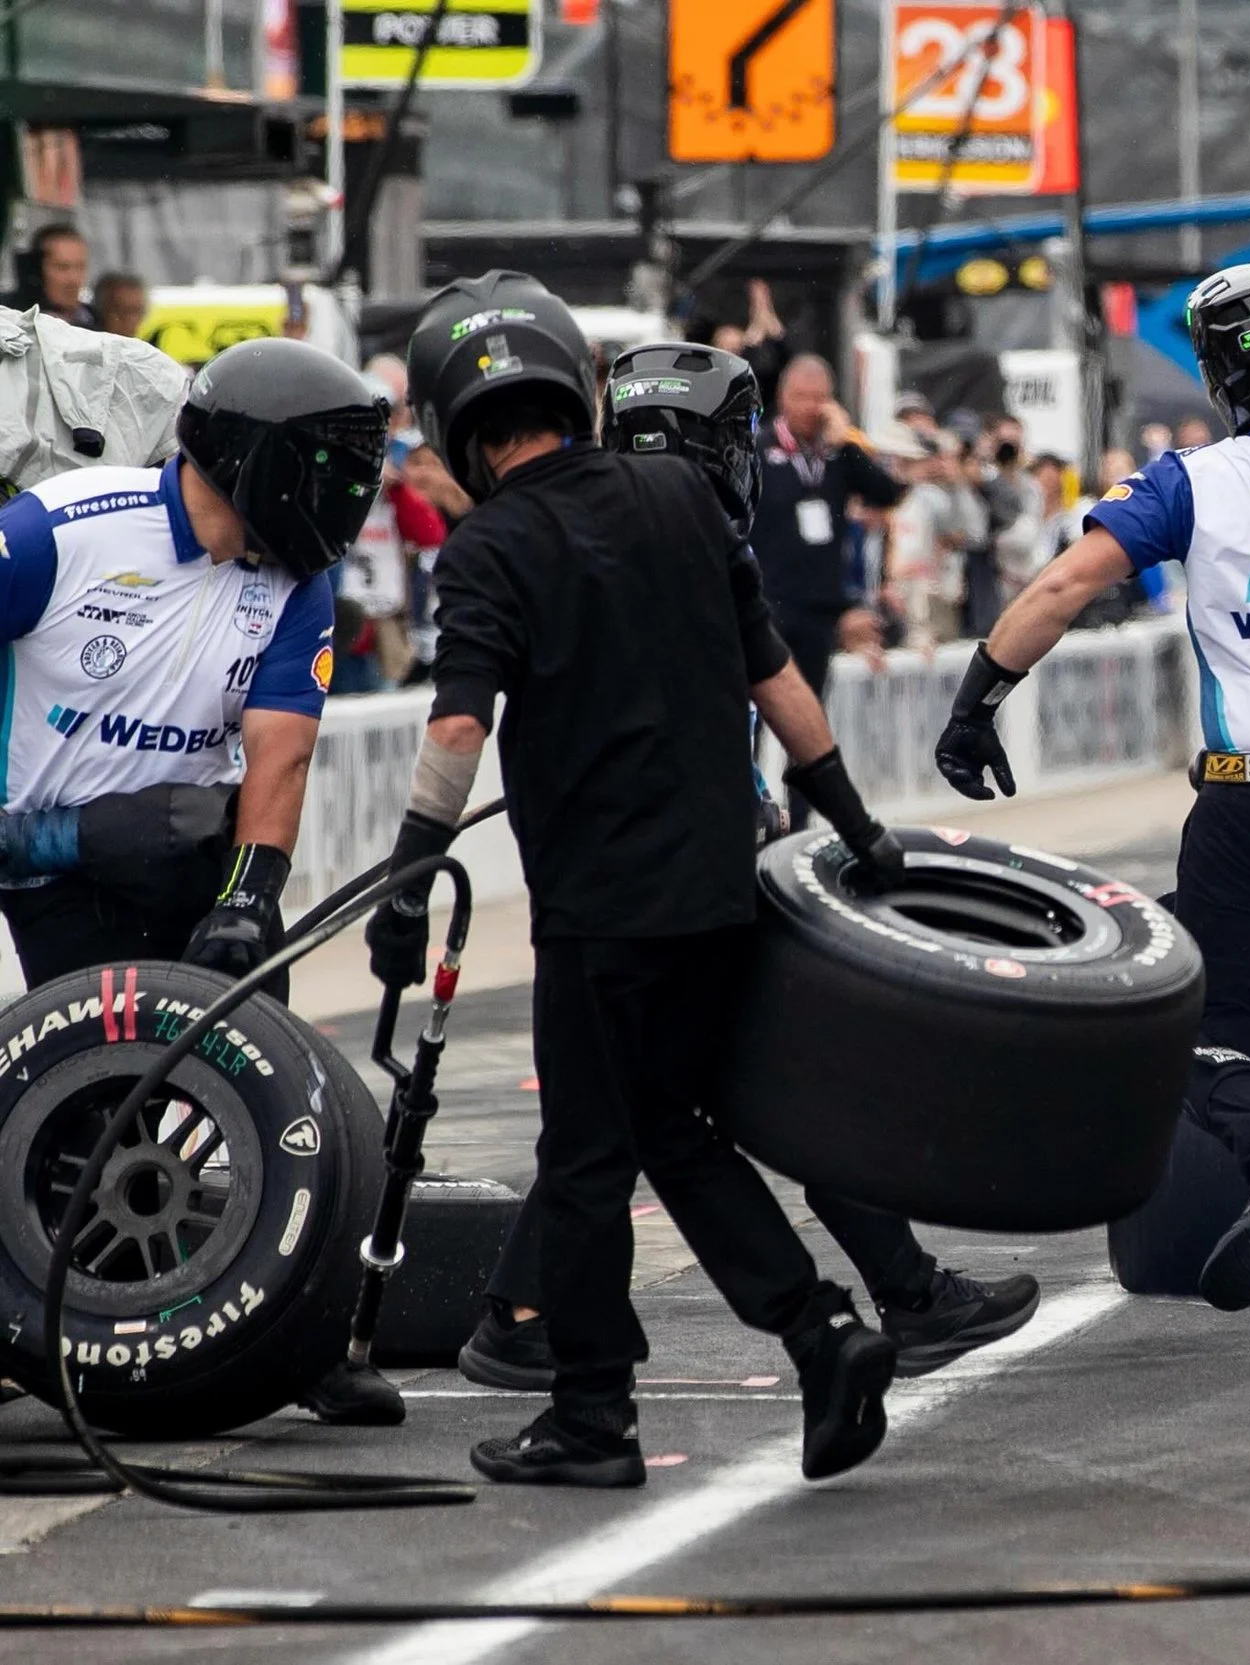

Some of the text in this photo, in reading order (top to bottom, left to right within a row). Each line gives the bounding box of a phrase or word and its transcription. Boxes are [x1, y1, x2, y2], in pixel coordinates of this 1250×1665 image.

[63, 494, 149, 520] Firestone
[100, 713, 241, 755] WEDBUS
[225, 1029, 275, 1077] 500
